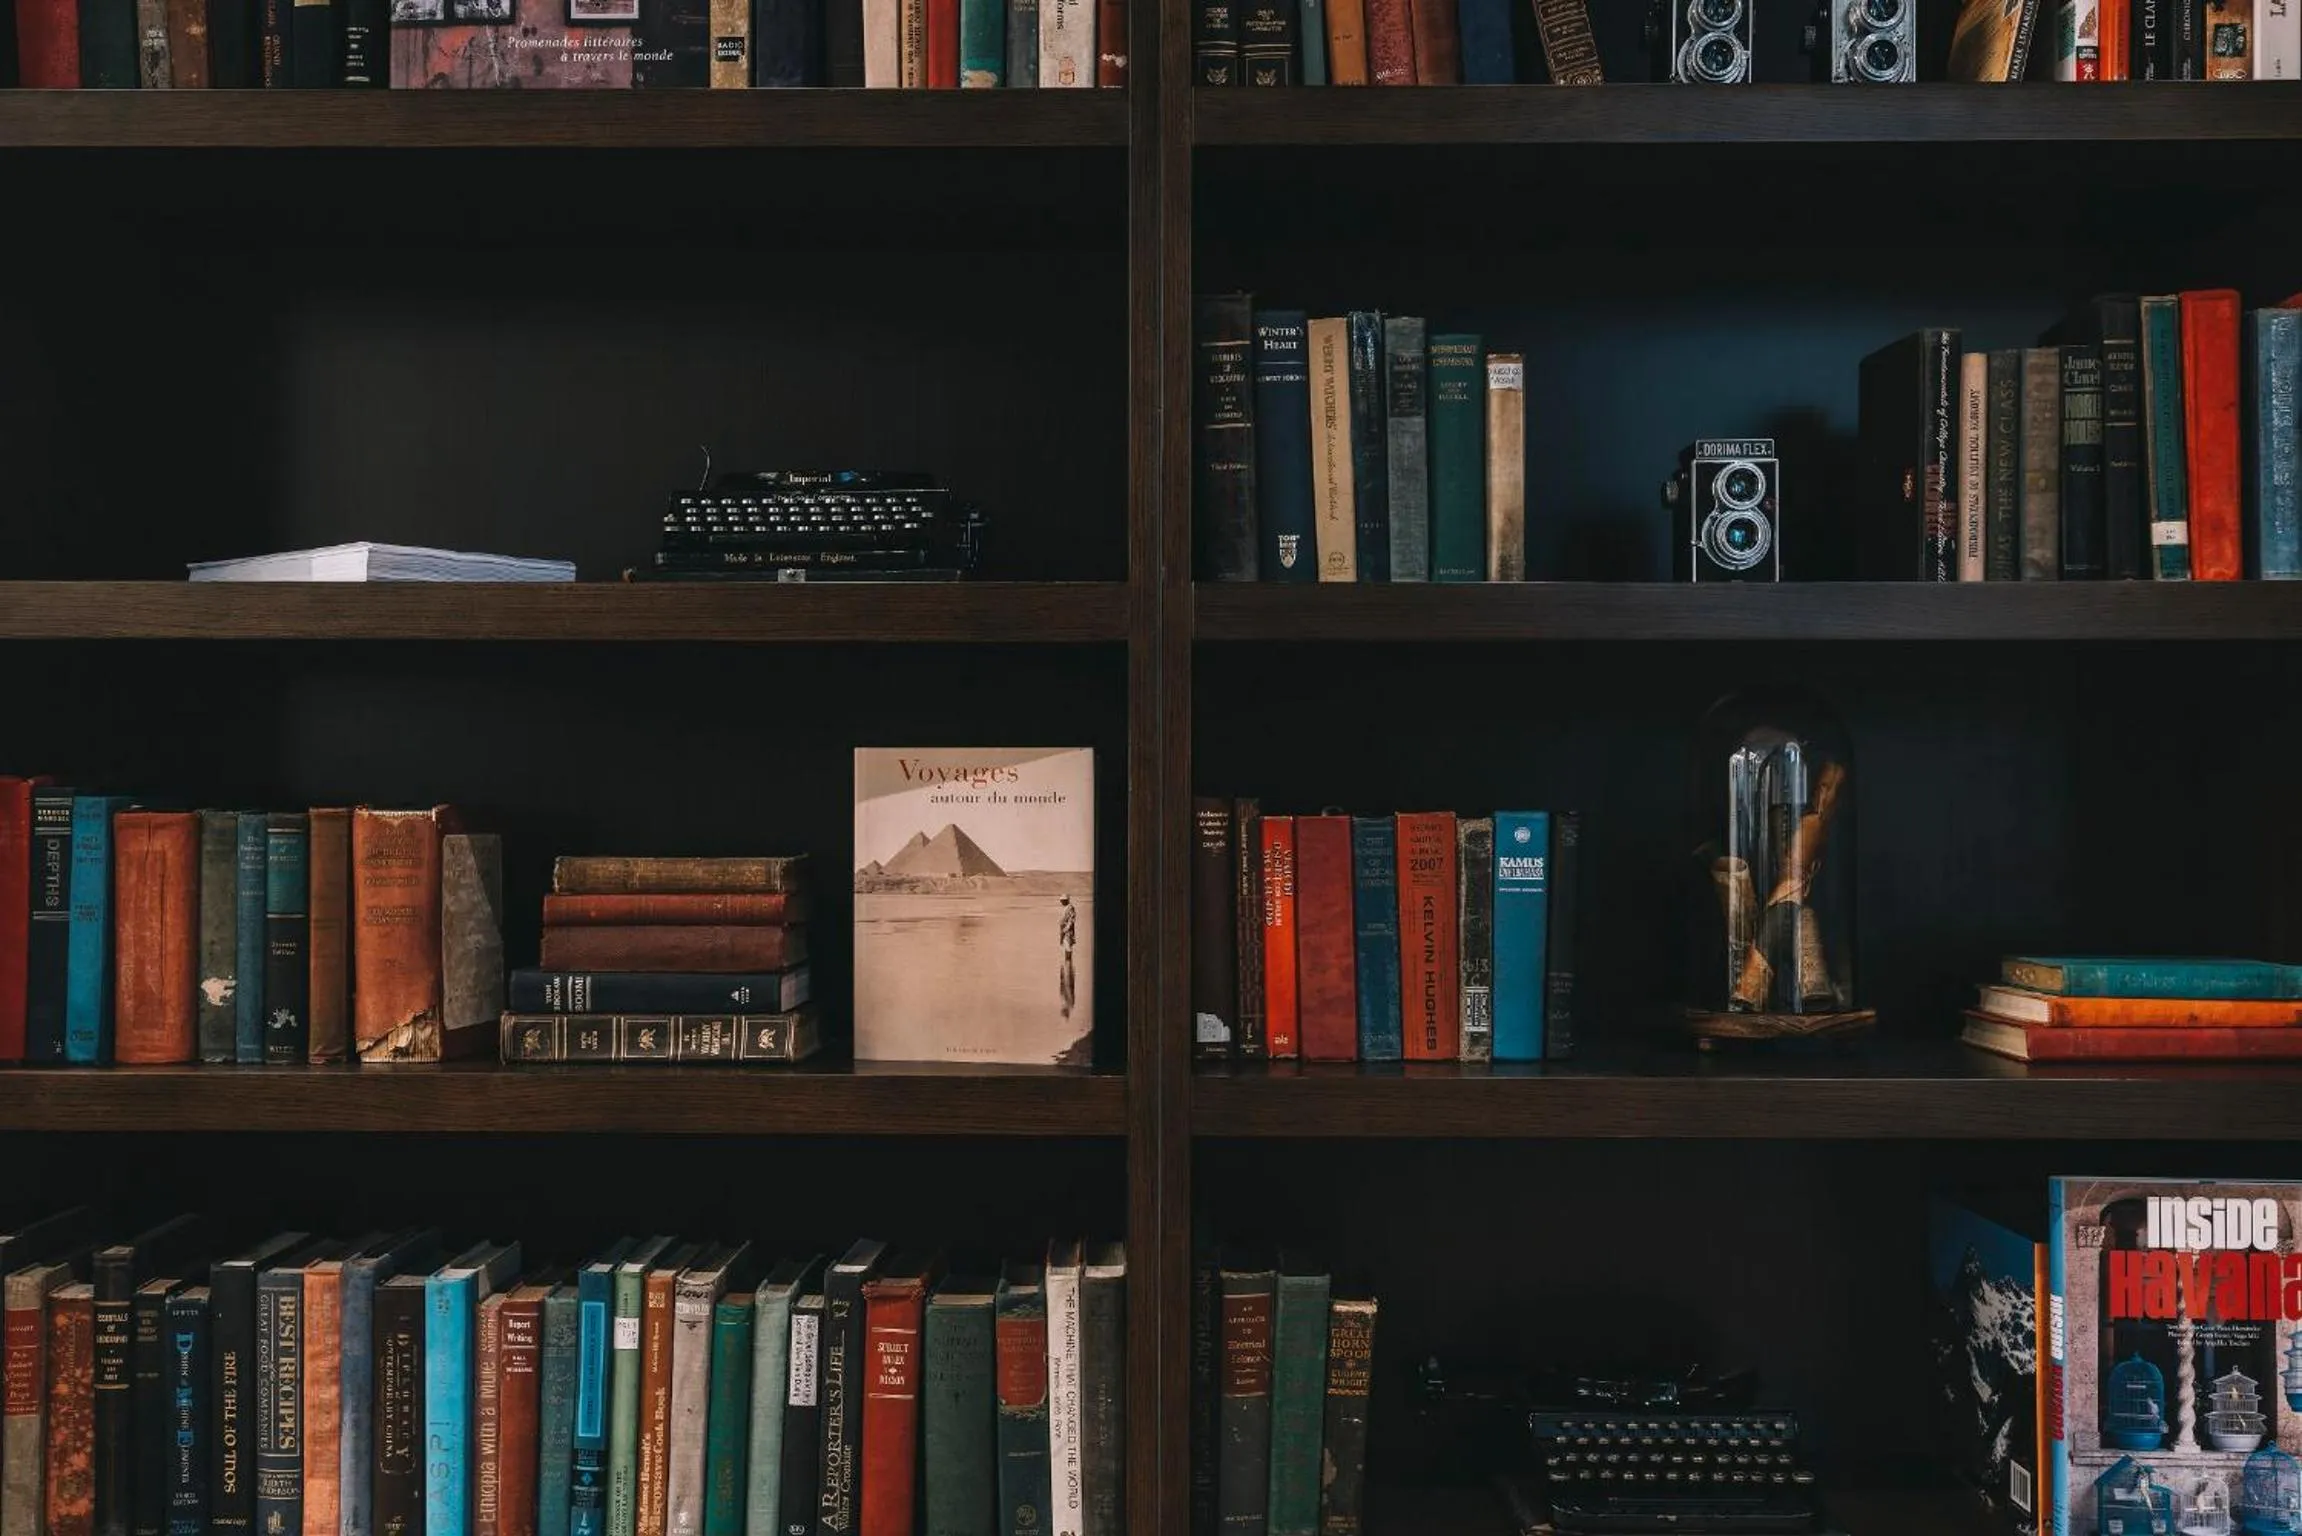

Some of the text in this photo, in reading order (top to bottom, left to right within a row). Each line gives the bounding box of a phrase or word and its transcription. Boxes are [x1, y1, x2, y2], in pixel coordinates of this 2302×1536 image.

[508, 35, 644, 48] Promenades littéraires
[560, 49, 674, 61] à travers le monde
[2145, 30, 2156, 47] LE
[1257, 327, 1303, 338] WINTER'S
[1263, 338, 1298, 351] HEART
[1939, 345, 1951, 408] Fundamentals
[1936, 408, 1949, 418] of
[2000, 379, 2018, 436] CLASS
[1936, 418, 1949, 449] College
[789, 473, 832, 486] Imperial
[1935, 450, 1948, 493] Chemistry
[1999, 440, 2016, 487] NEW
[1998, 488, 2014, 522] THE
[724, 553, 749, 563] Made
[897, 758, 1019, 790] Voyages
[930, 790, 1067, 806] autour du monde
[46, 839, 60, 907] DEPTHS
[1409, 857, 1444, 871] 2007
[1500, 857, 1544, 867] KAMUS
[1422, 895, 1438, 1051] KELVIN HUGHES
[2108, 1250, 2302, 1322] Havana
[507, 1332, 533, 1344] Writing
[508, 1319, 531, 1330] Report
[1329, 1347, 1372, 1359] SPOON
[1332, 1338, 1370, 1349] HORN
[259, 1294, 270, 1449] GREAT FOOD COMPANIES
[279, 1295, 298, 1449] BEST RECIPES
[654, 1387, 666, 1421] Book
[1066, 1287, 1078, 1509] THE MACHINE THAT CHANGED THE WORLD
[223, 1351, 237, 1494] SOUL OF THE FIRE
[653, 1422, 664, 1454] Cook
[822, 1346, 843, 1532] A REPORTER'S LIFE
[384, 1423, 394, 1458] CHINA
[478, 1361, 500, 1523] Ethiopia with a Mule
[839, 1445, 853, 1530] Walter Cronkite
[638, 1483, 651, 1534] Madame
